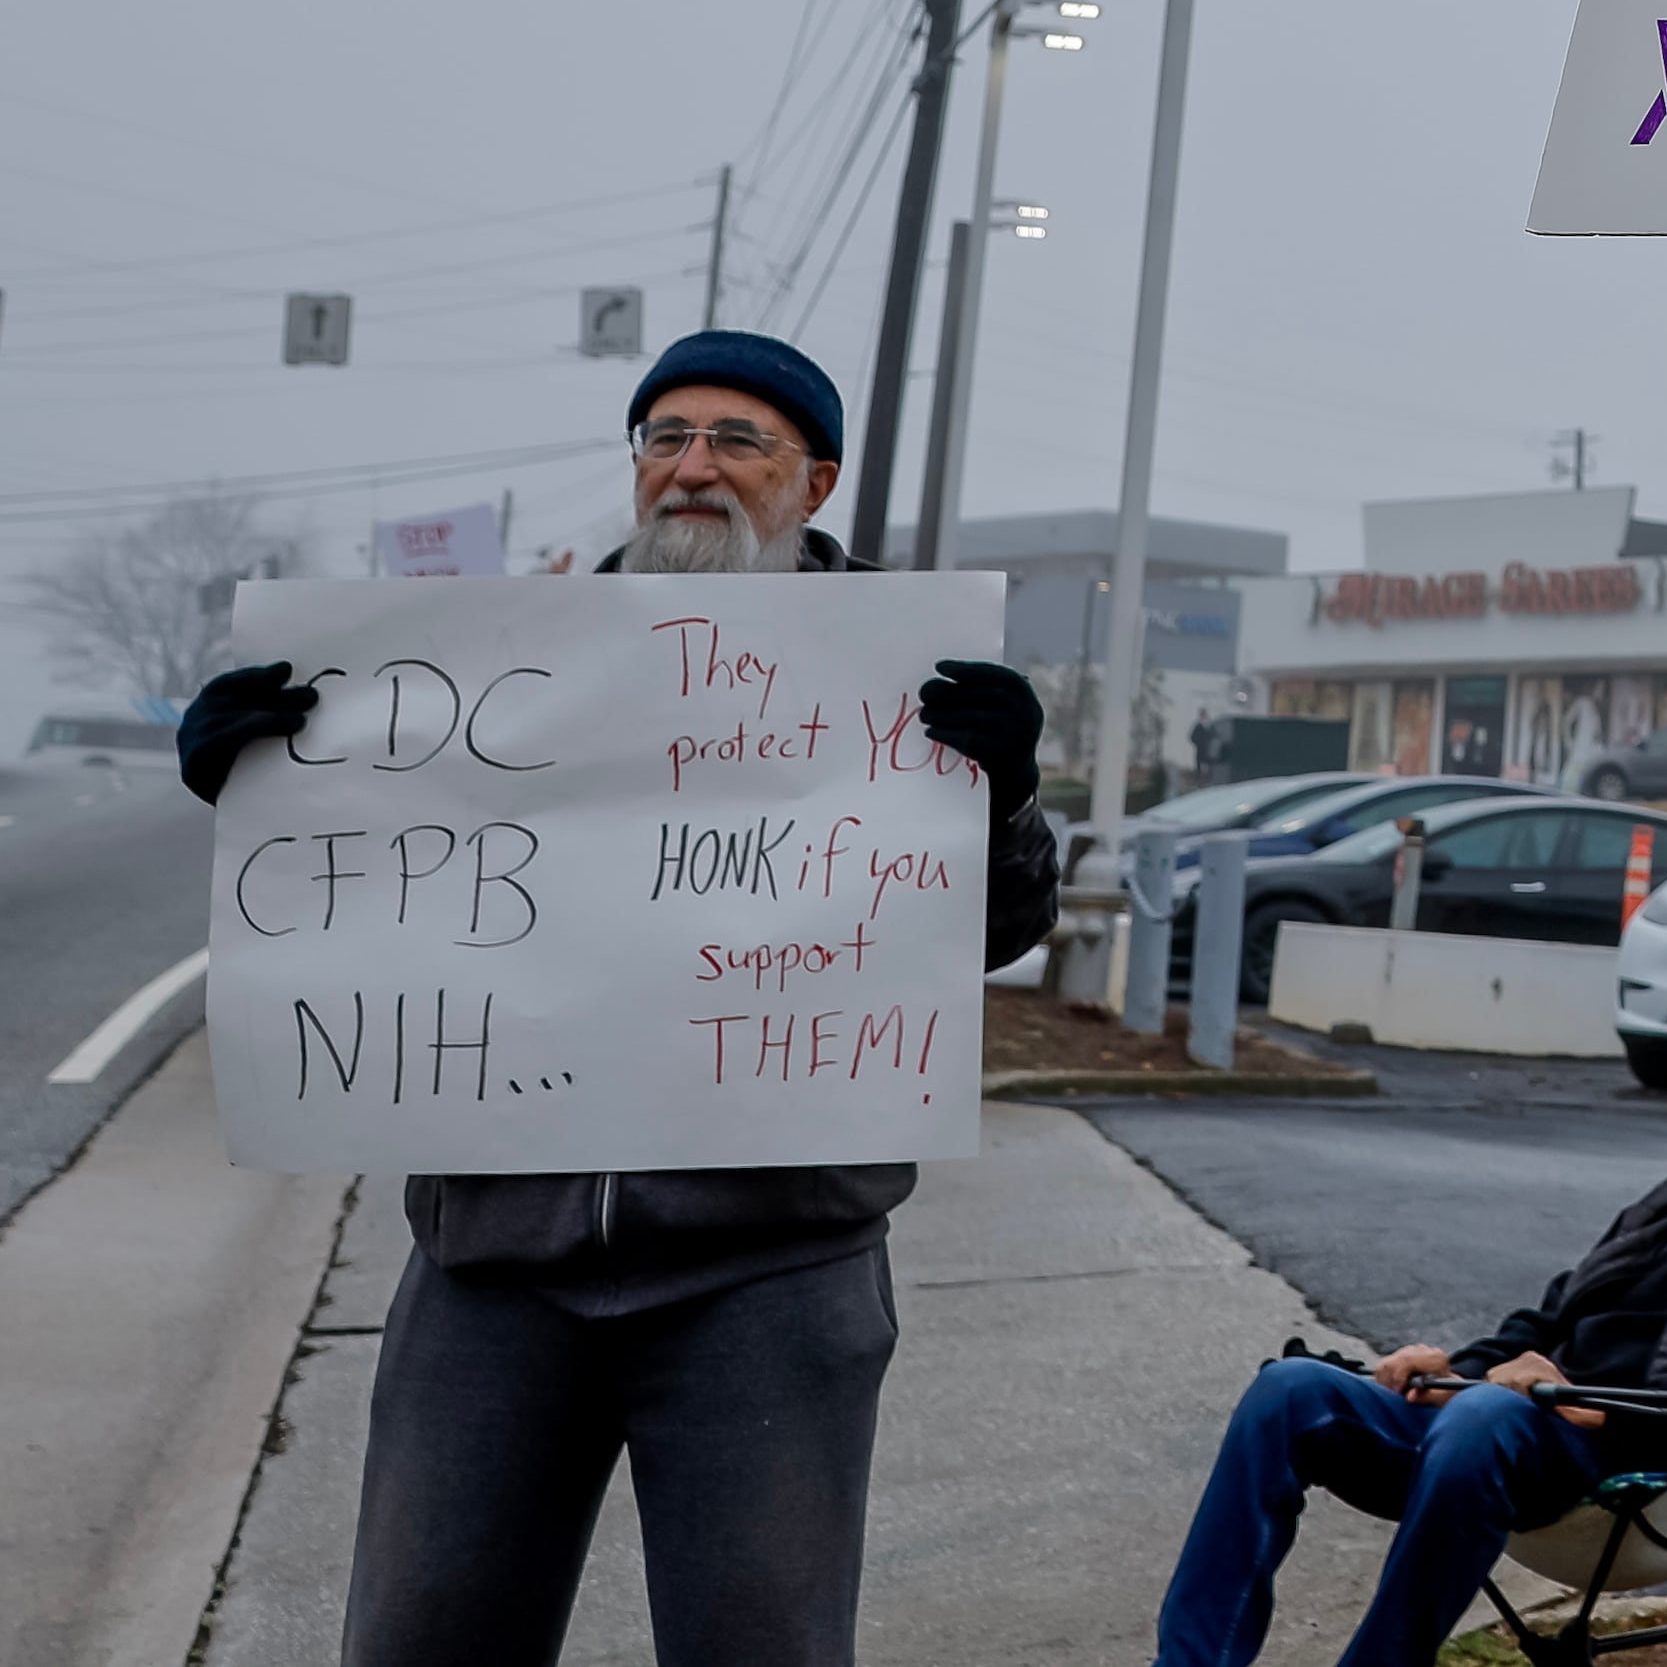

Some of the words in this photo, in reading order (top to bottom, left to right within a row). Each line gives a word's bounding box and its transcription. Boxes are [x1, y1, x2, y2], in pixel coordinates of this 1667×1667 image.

[286, 659, 556, 773] CDC
[651, 617, 776, 718] They
[667, 702, 831, 791] protect
[237, 822, 539, 948] CFPB
[650, 816, 796, 902] HONK
[799, 817, 861, 898] if
[869, 849, 951, 919] you
[696, 923, 873, 991] support
[292, 988, 573, 1104] NIH...
[688, 1006, 938, 1105] THEM!
